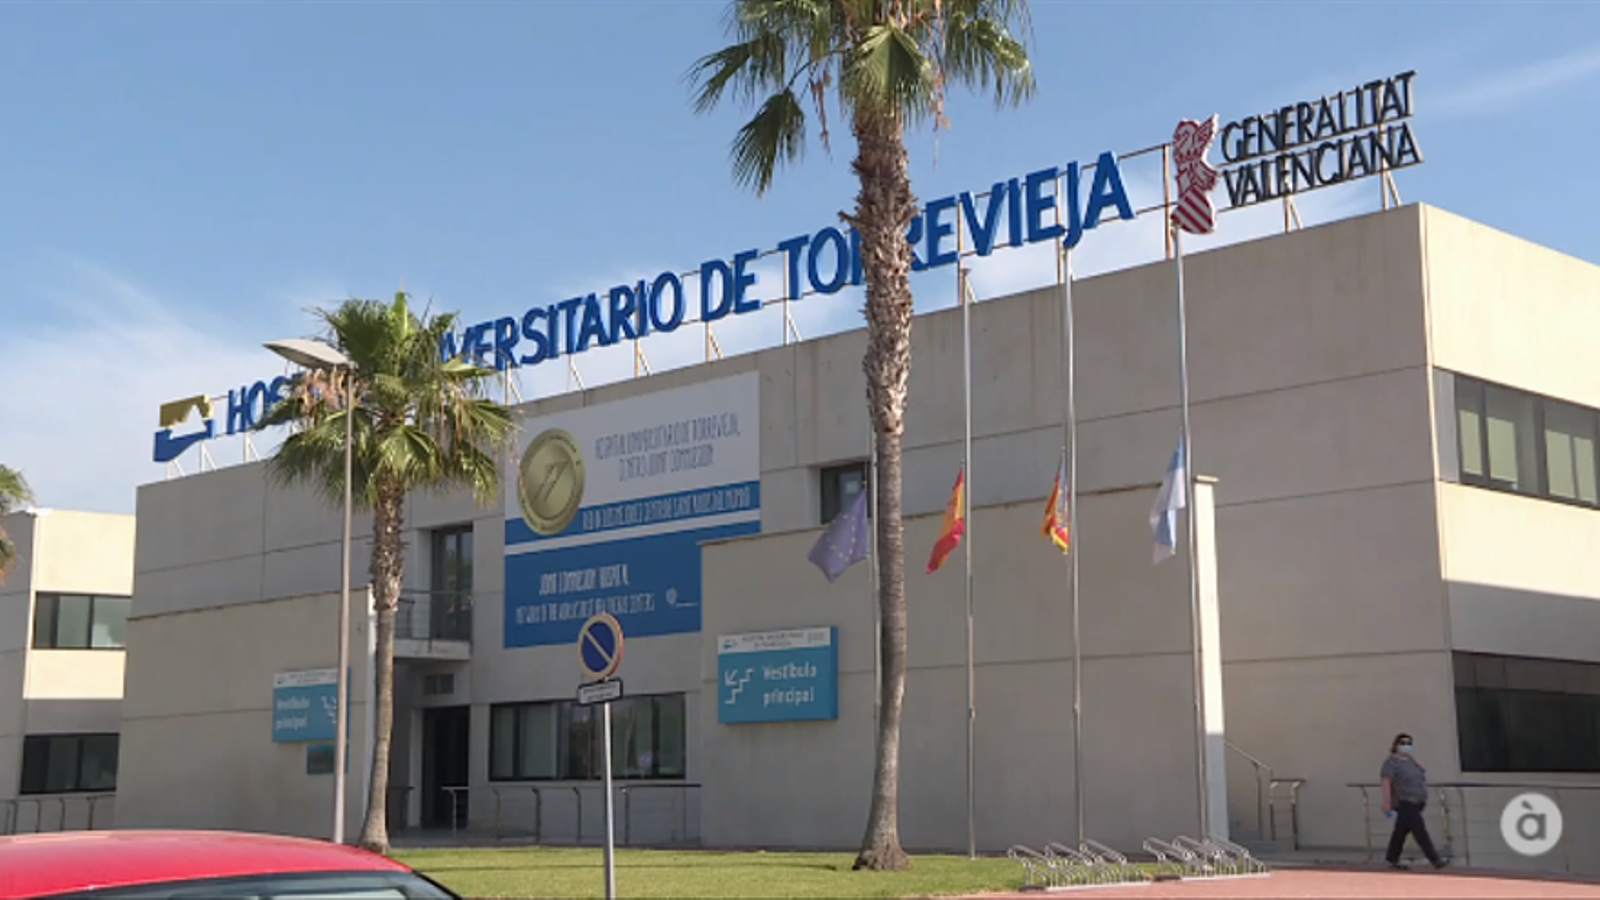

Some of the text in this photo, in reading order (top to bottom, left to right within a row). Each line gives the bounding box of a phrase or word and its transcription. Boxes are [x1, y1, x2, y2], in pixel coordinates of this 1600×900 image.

[1221, 70, 1418, 163] GENERALITAT
[1223, 122, 1424, 209] VALENCIANA
[700, 248, 762, 323] DE
[763, 687, 815, 708] principal
